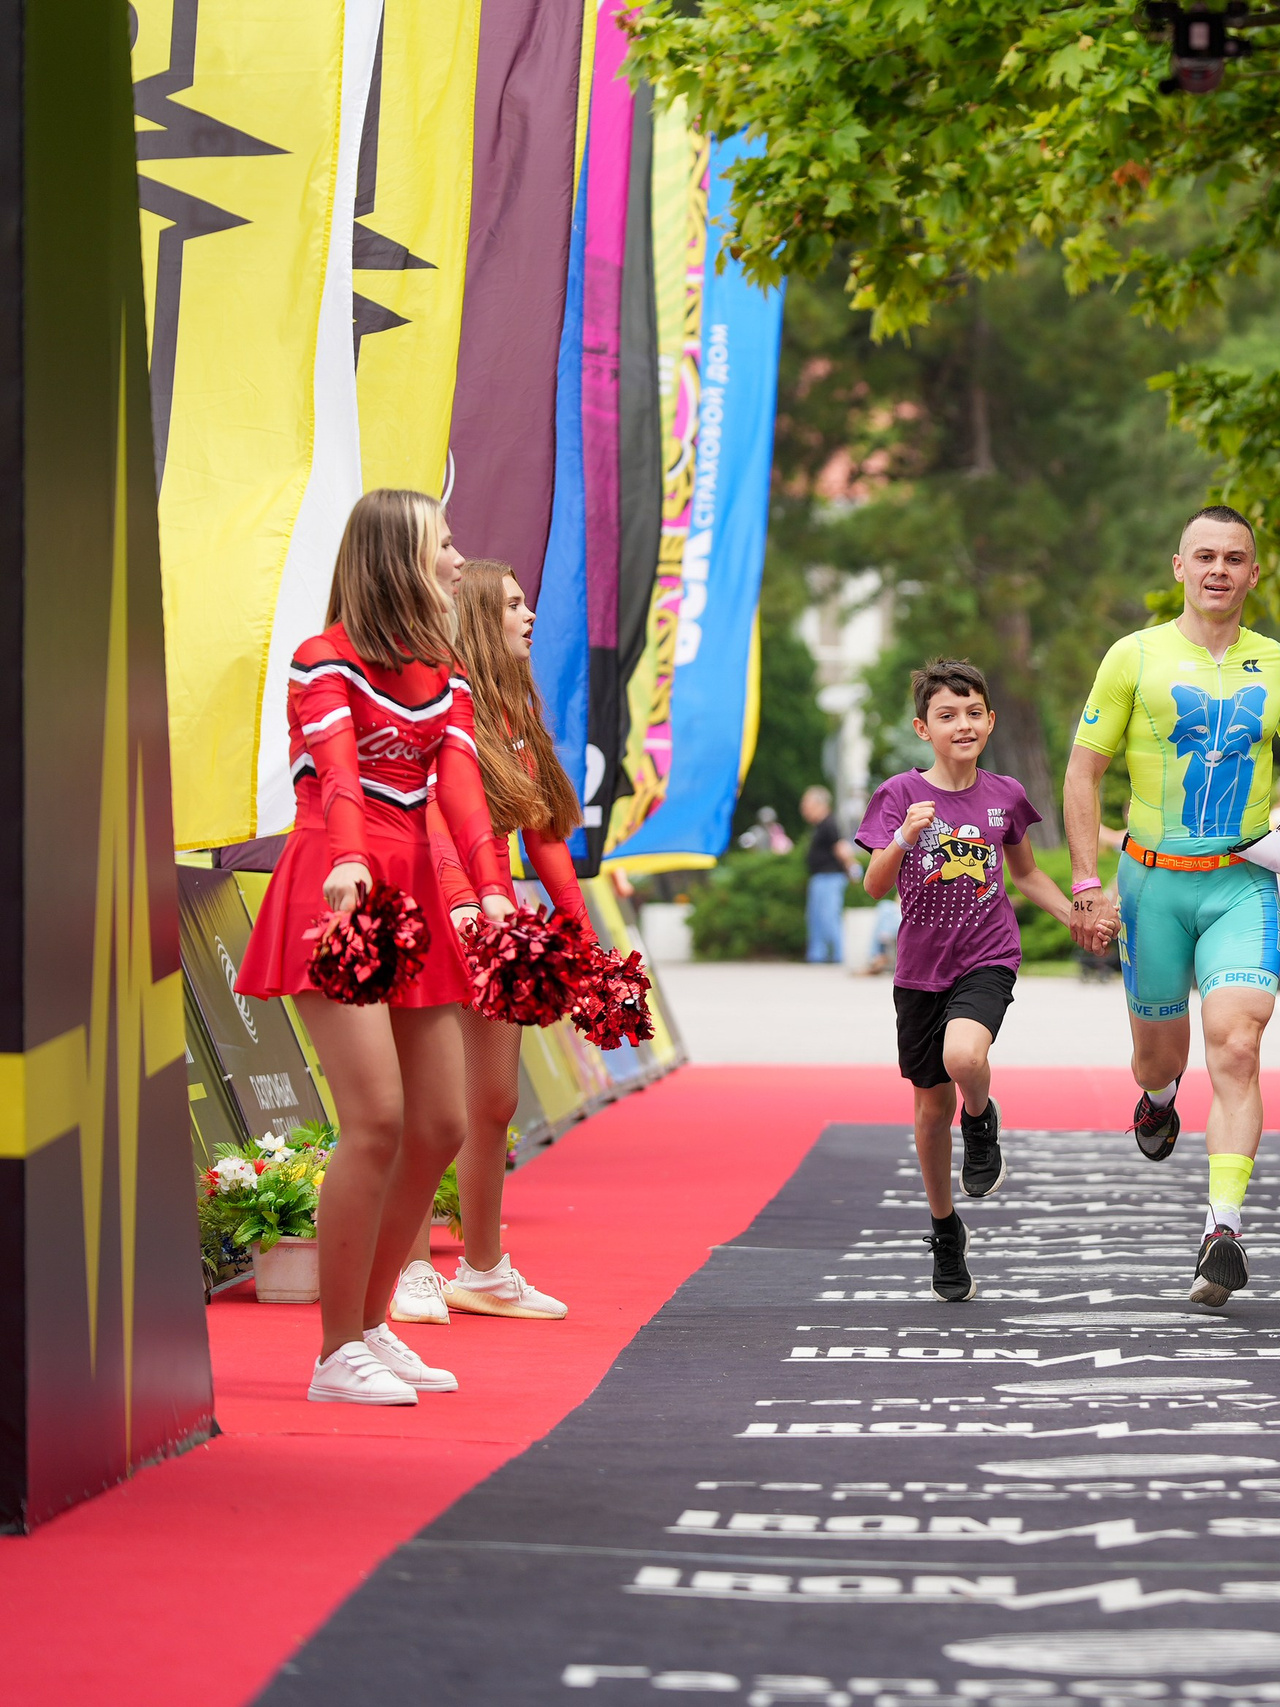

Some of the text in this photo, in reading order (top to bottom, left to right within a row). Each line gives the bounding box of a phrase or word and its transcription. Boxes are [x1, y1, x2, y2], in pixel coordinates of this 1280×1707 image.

[1074, 900, 1093, 912] 216
[1225, 972, 1272, 987] BREW
[790, 1346, 1039, 1358] IRON
[744, 1421, 1033, 1434] IRON
[676, 1509, 1023, 1533] IRON
[634, 1566, 1016, 1595] IRON
